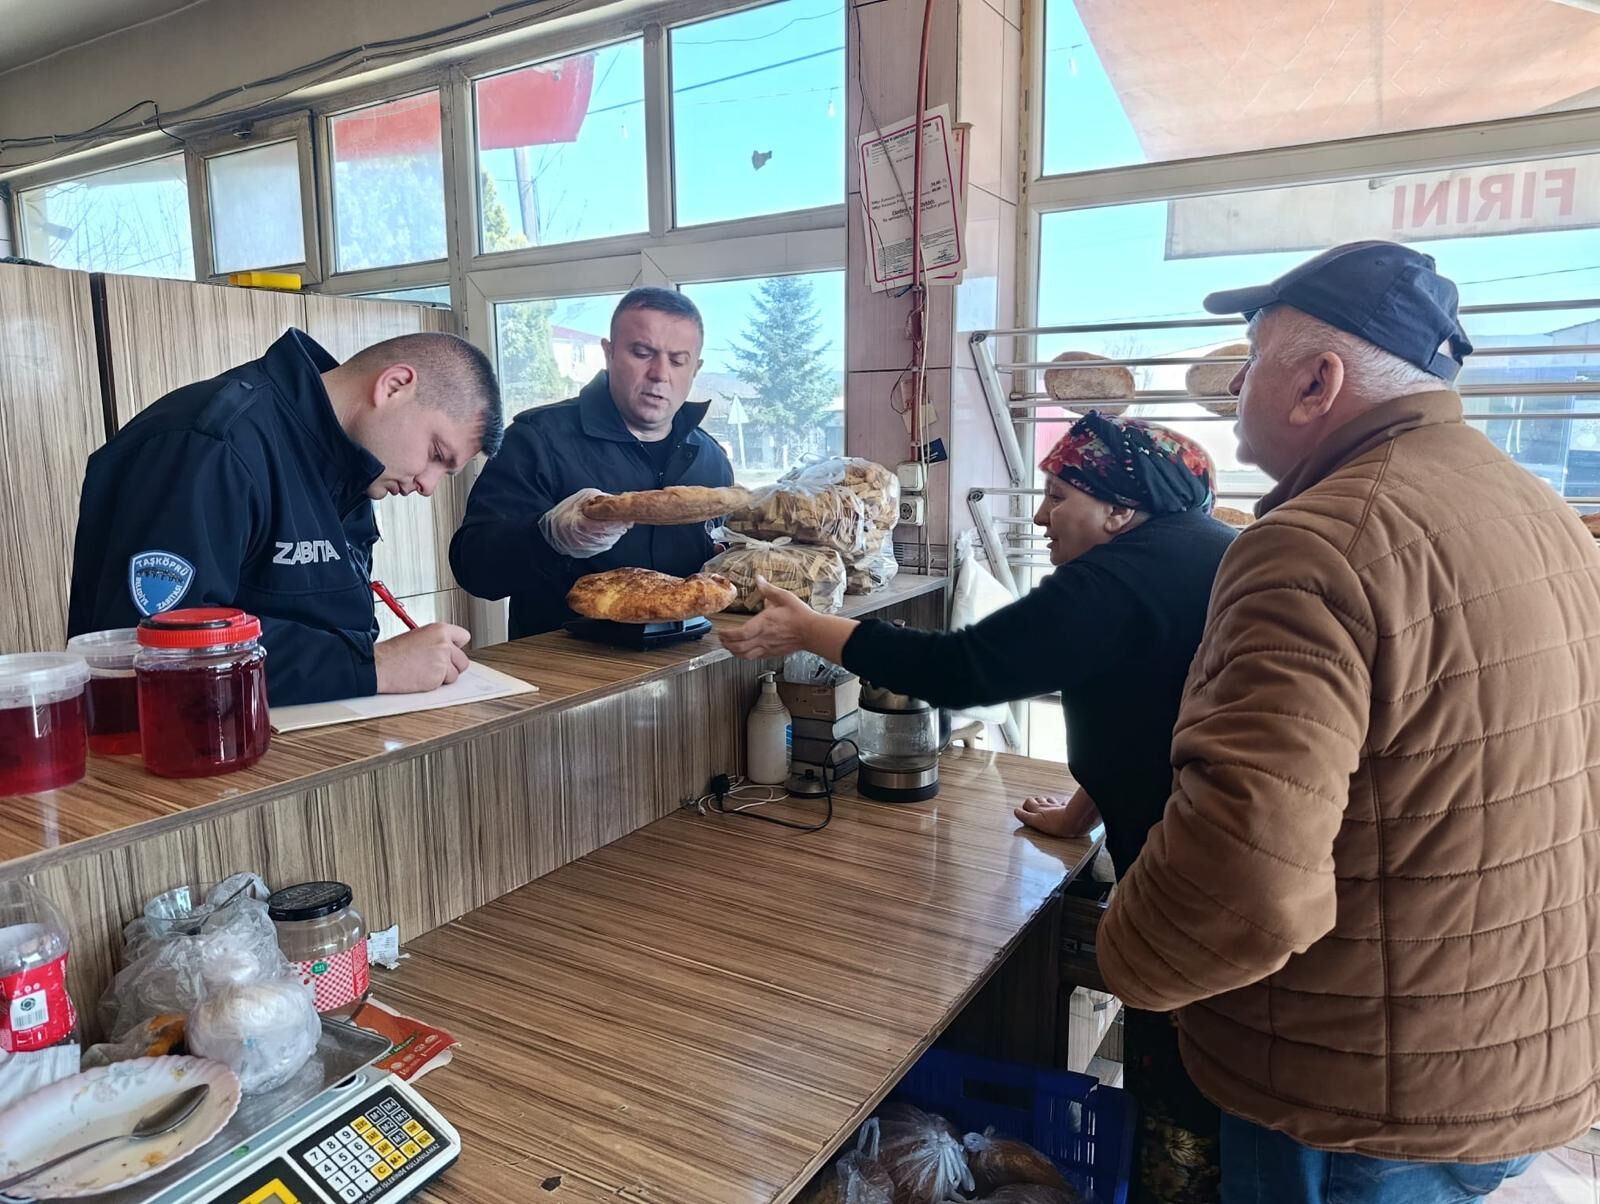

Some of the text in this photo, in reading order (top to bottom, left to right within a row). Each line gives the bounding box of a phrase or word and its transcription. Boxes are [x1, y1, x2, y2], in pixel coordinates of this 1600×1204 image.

[135, 556, 190, 576] TAŞKÖPRÜ
[272, 540, 341, 566] ZABITA
[310, 1151, 320, 1161] 7
[326, 1140, 336, 1150] 8
[342, 1130, 351, 1139] 9
[370, 1109, 382, 1120] M1
[384, 1100, 396, 1111] M4
[323, 1164, 333, 1173] 4
[339, 1153, 348, 1162] 5
[354, 1142, 363, 1151] 6
[381, 1121, 394, 1132] M2
[395, 1111, 408, 1122] M5
[335, 1176, 345, 1185] 1
[350, 1165, 360, 1174] 2
[365, 1154, 375, 1163] 3
[392, 1132, 405, 1143] M3
[346, 1188, 356, 1198] 0
[377, 1166, 386, 1175] C
[390, 1155, 402, 1166] M+
